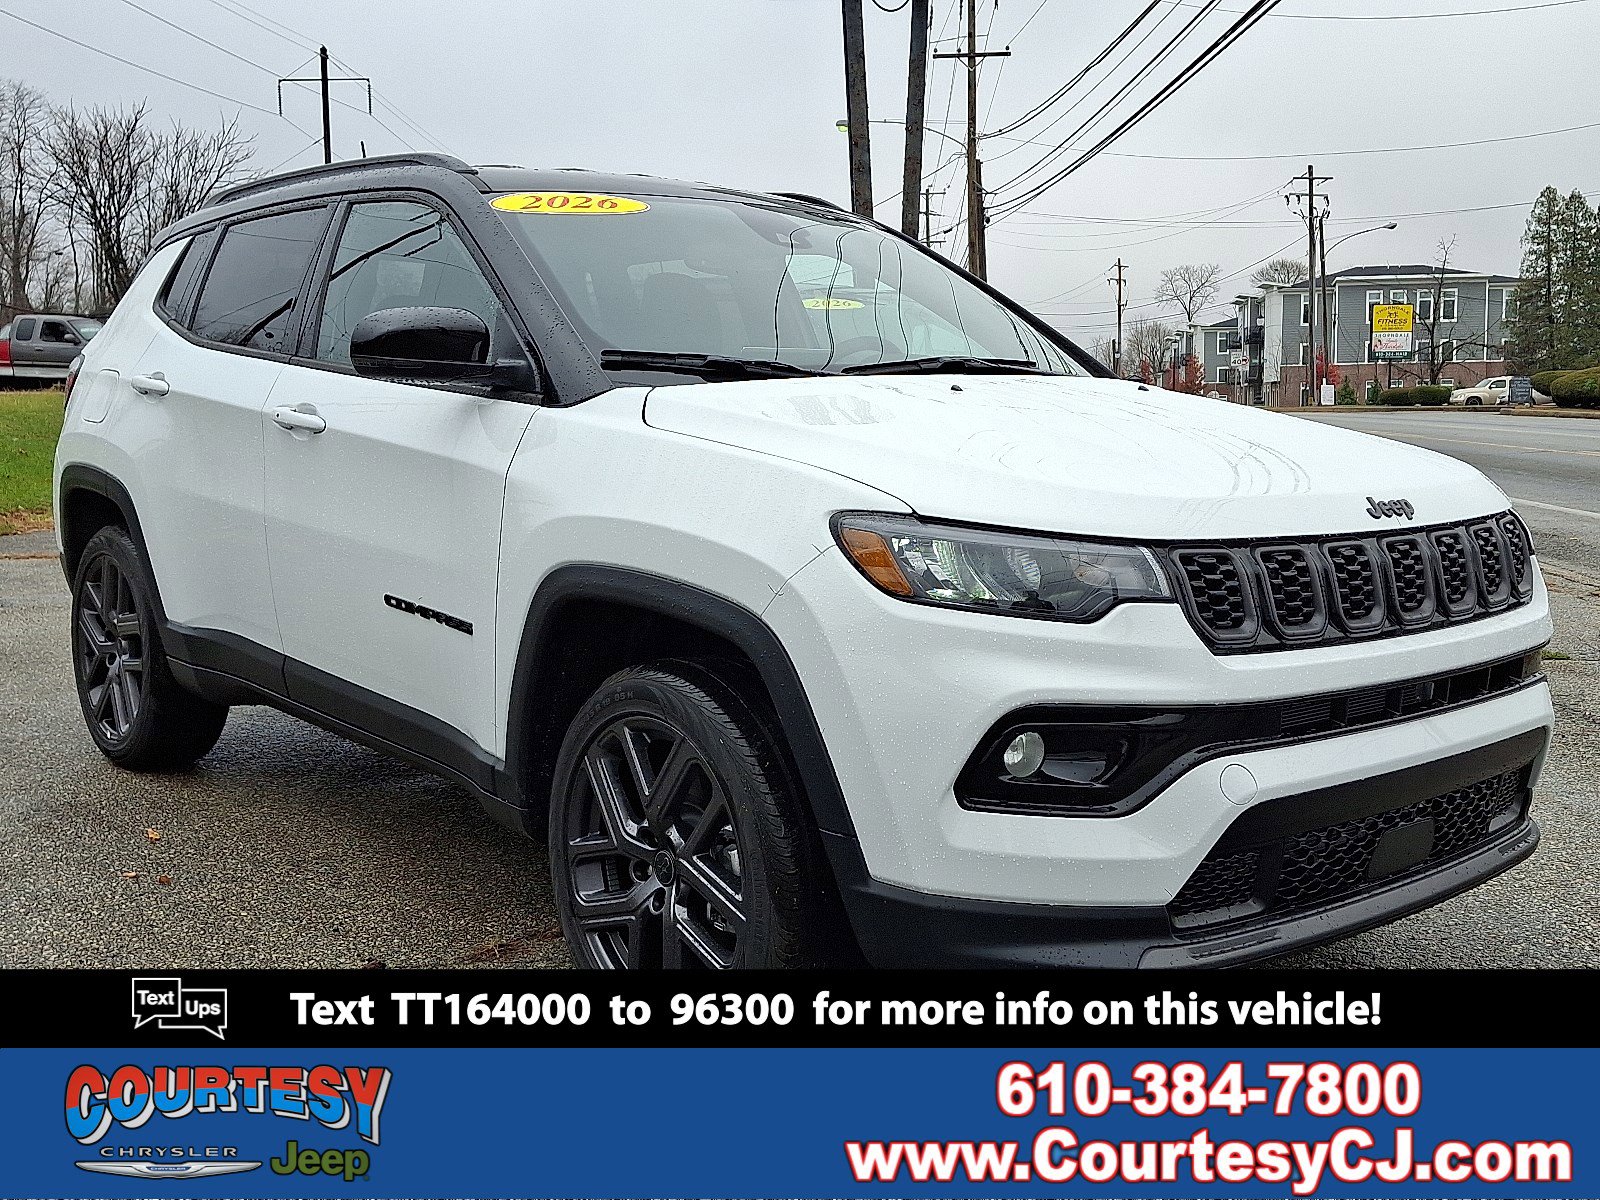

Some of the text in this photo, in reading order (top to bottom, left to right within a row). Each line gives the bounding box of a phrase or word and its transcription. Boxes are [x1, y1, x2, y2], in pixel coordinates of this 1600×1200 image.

[520, 195, 618, 210] 2026
[1365, 496, 1415, 520] Jeep
[383, 593, 474, 636] COMPASS
